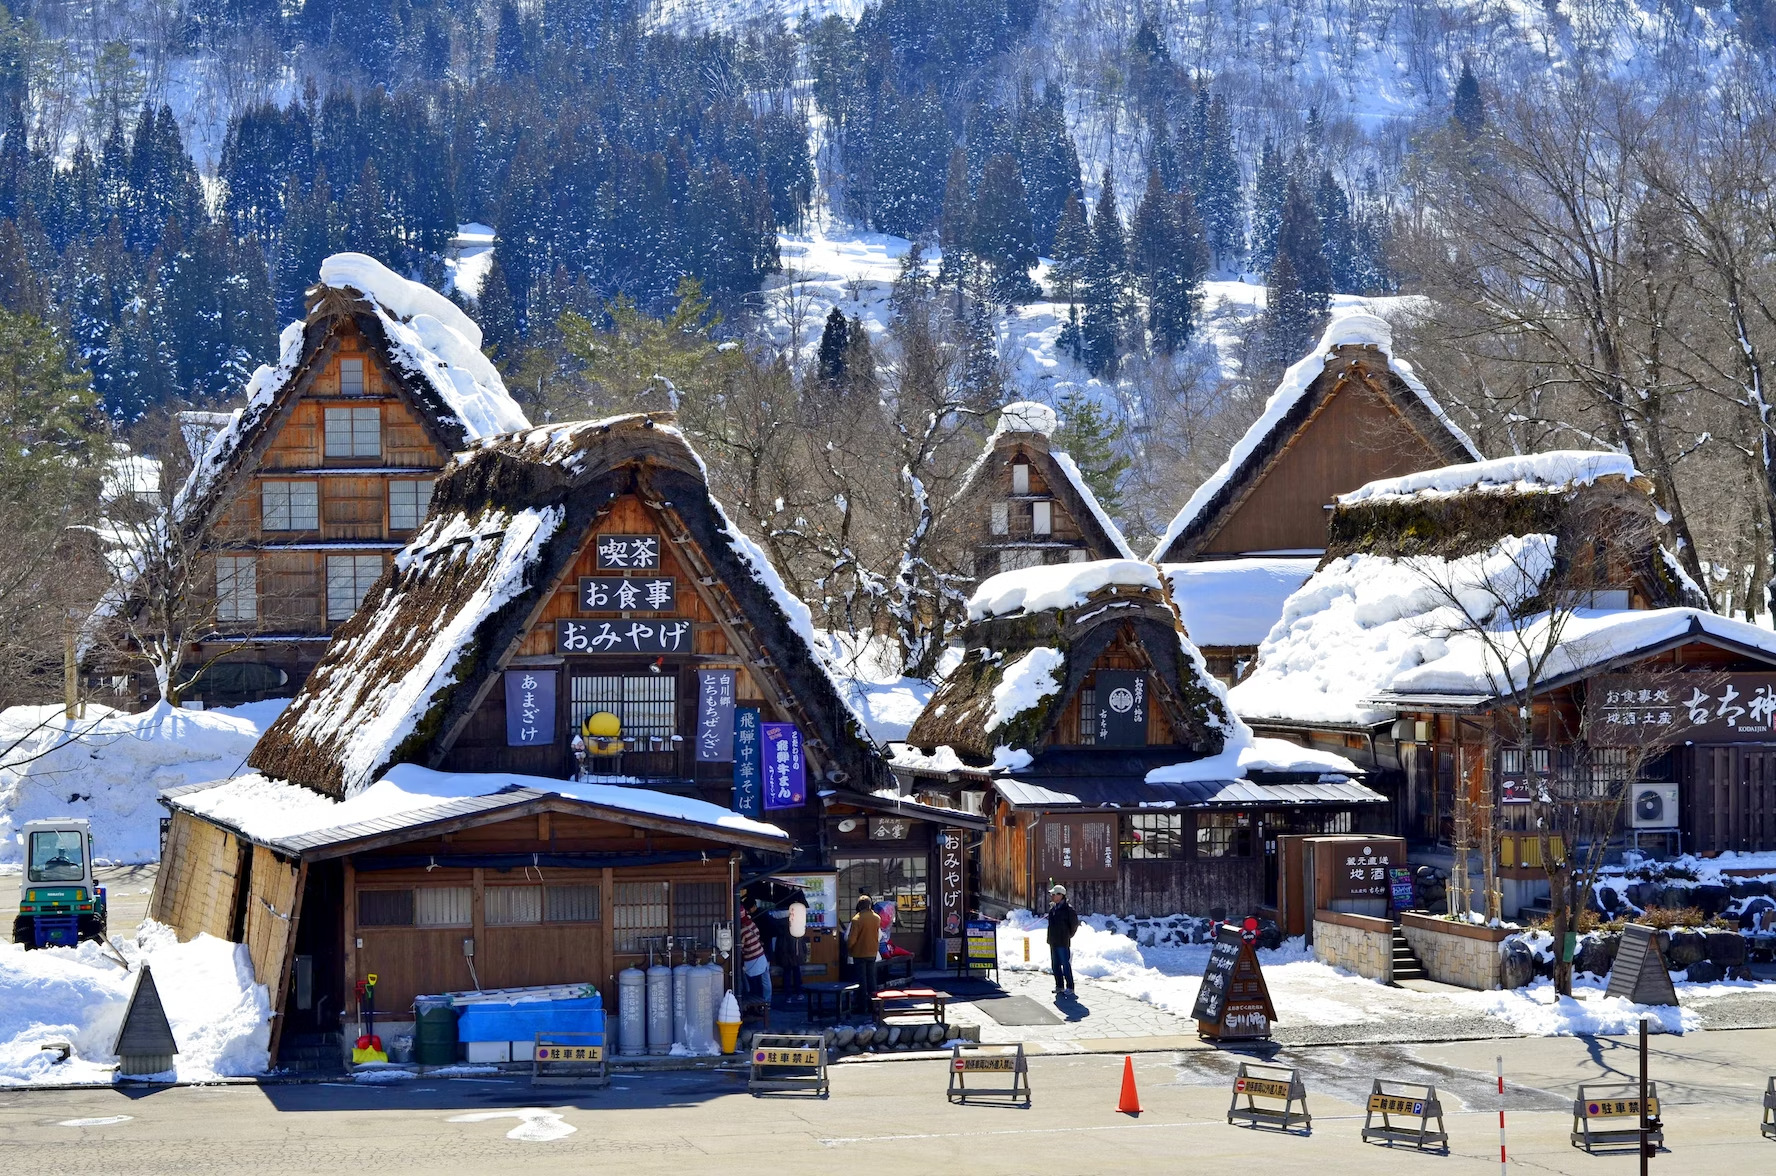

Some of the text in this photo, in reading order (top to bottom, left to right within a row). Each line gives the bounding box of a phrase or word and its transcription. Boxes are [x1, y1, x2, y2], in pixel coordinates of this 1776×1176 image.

[599, 538, 658, 568] 喫茶
[586, 580, 672, 610] お食事
[563, 621, 690, 652] おみやげ
[720, 674, 731, 707] 白川郷
[1606, 688, 1670, 704] お食事処
[521, 674, 540, 741] あまざけ
[702, 674, 720, 758] とちもちぜんざい
[944, 835, 961, 907] おみやげ
[1346, 856, 1389, 866] 蔵元直送
[1350, 868, 1385, 880] 地酒
[1225, 1012, 1267, 1029] 白川郷
[551, 1048, 598, 1059] 駐車禁止
[767, 1053, 814, 1064] 駐車禁止
[1371, 1098, 1412, 1113] 二輪車専用
